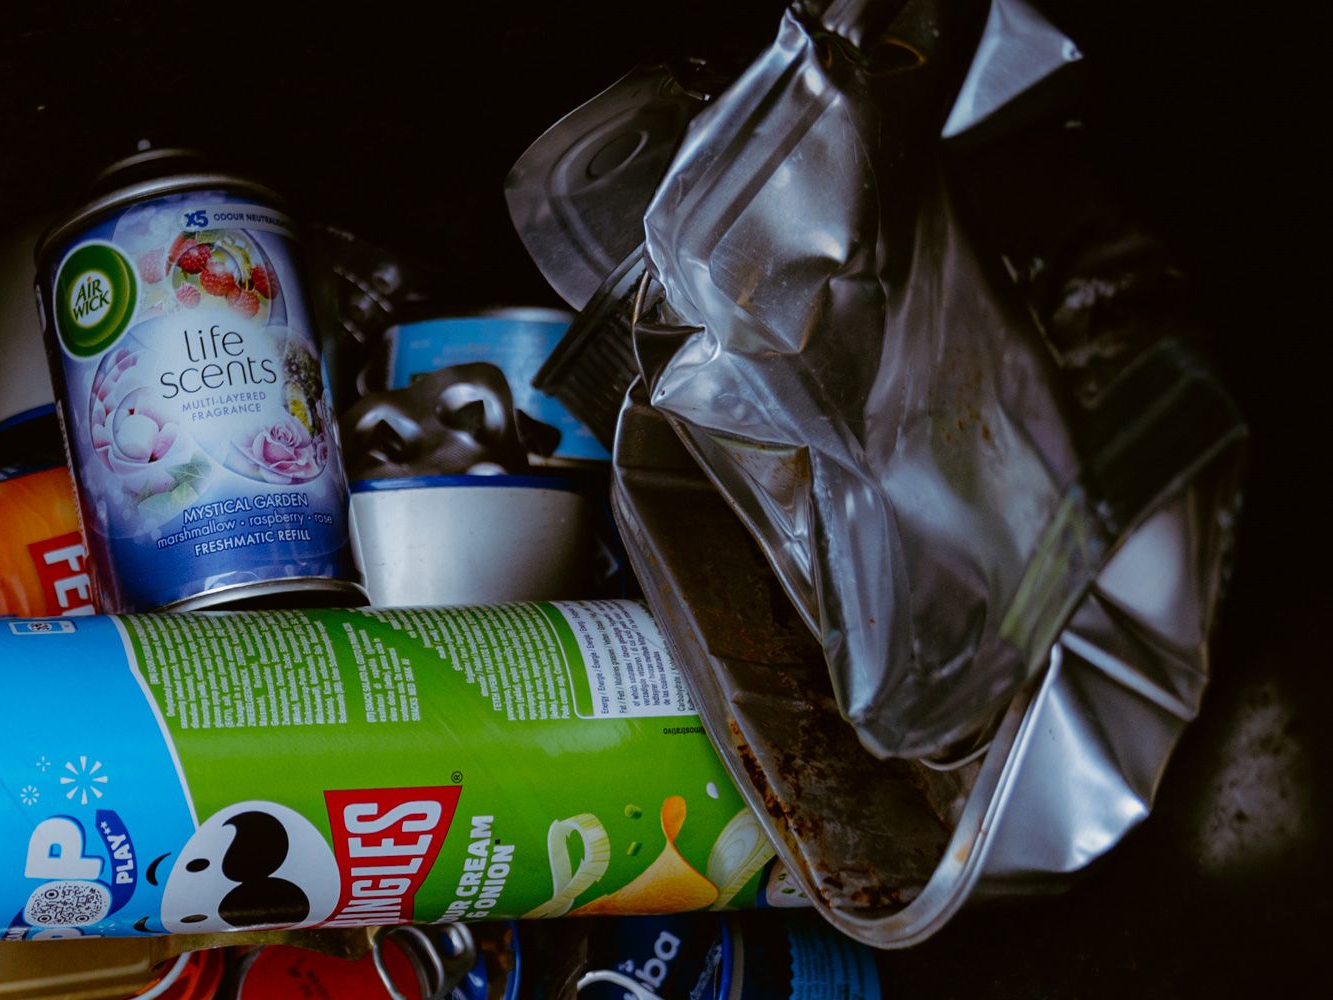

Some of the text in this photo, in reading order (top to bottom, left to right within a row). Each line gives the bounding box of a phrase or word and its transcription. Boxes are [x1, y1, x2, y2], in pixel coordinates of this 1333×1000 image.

[184, 210, 208, 229] X5
[213, 212, 241, 223] ODOUR
[71, 291, 110, 322] WICK
[75, 277, 103, 306] AIR
[184, 325, 245, 363] life
[159, 356, 278, 400] scents
[181, 390, 267, 413] MULTI-LAYERED
[190, 402, 263, 423] FRAGRANCE
[182, 493, 309, 525] MYSTICAL GARDEN
[156, 511, 334, 549] marshmallow raspberry rose
[193, 529, 312, 558] FRESHMATIC REFILL
[457, 815, 495, 898] CREAM
[478, 844, 516, 911] ONION
